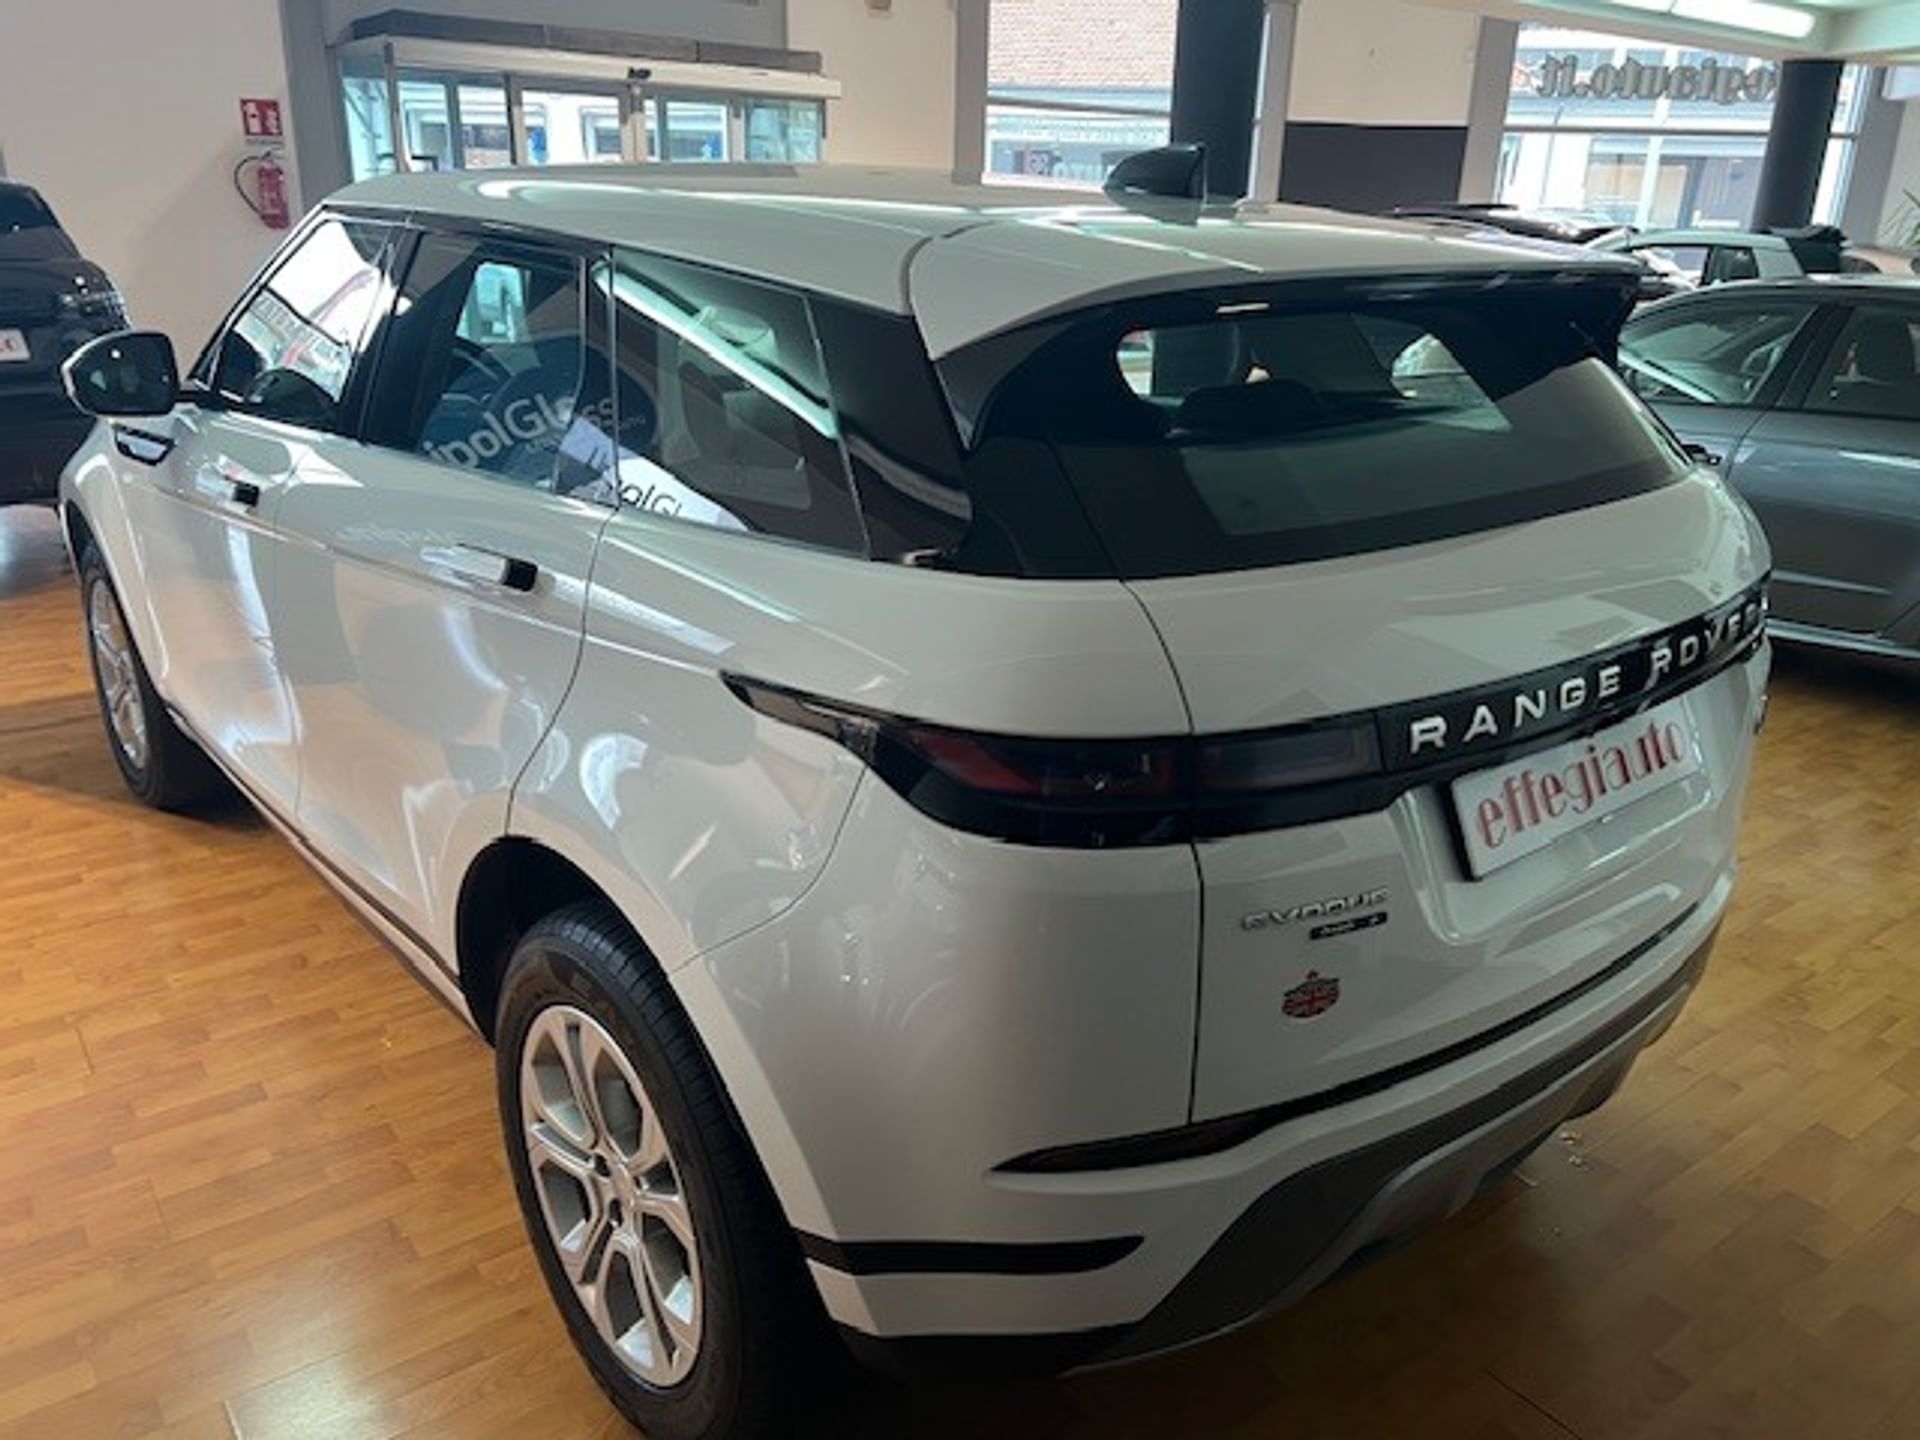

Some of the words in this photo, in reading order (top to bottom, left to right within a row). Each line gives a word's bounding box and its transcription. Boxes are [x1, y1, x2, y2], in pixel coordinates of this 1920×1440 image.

[1410, 665, 1622, 755] RANGE
[1649, 602, 1758, 677] ROVER
[1478, 720, 1683, 848] effegiauto
